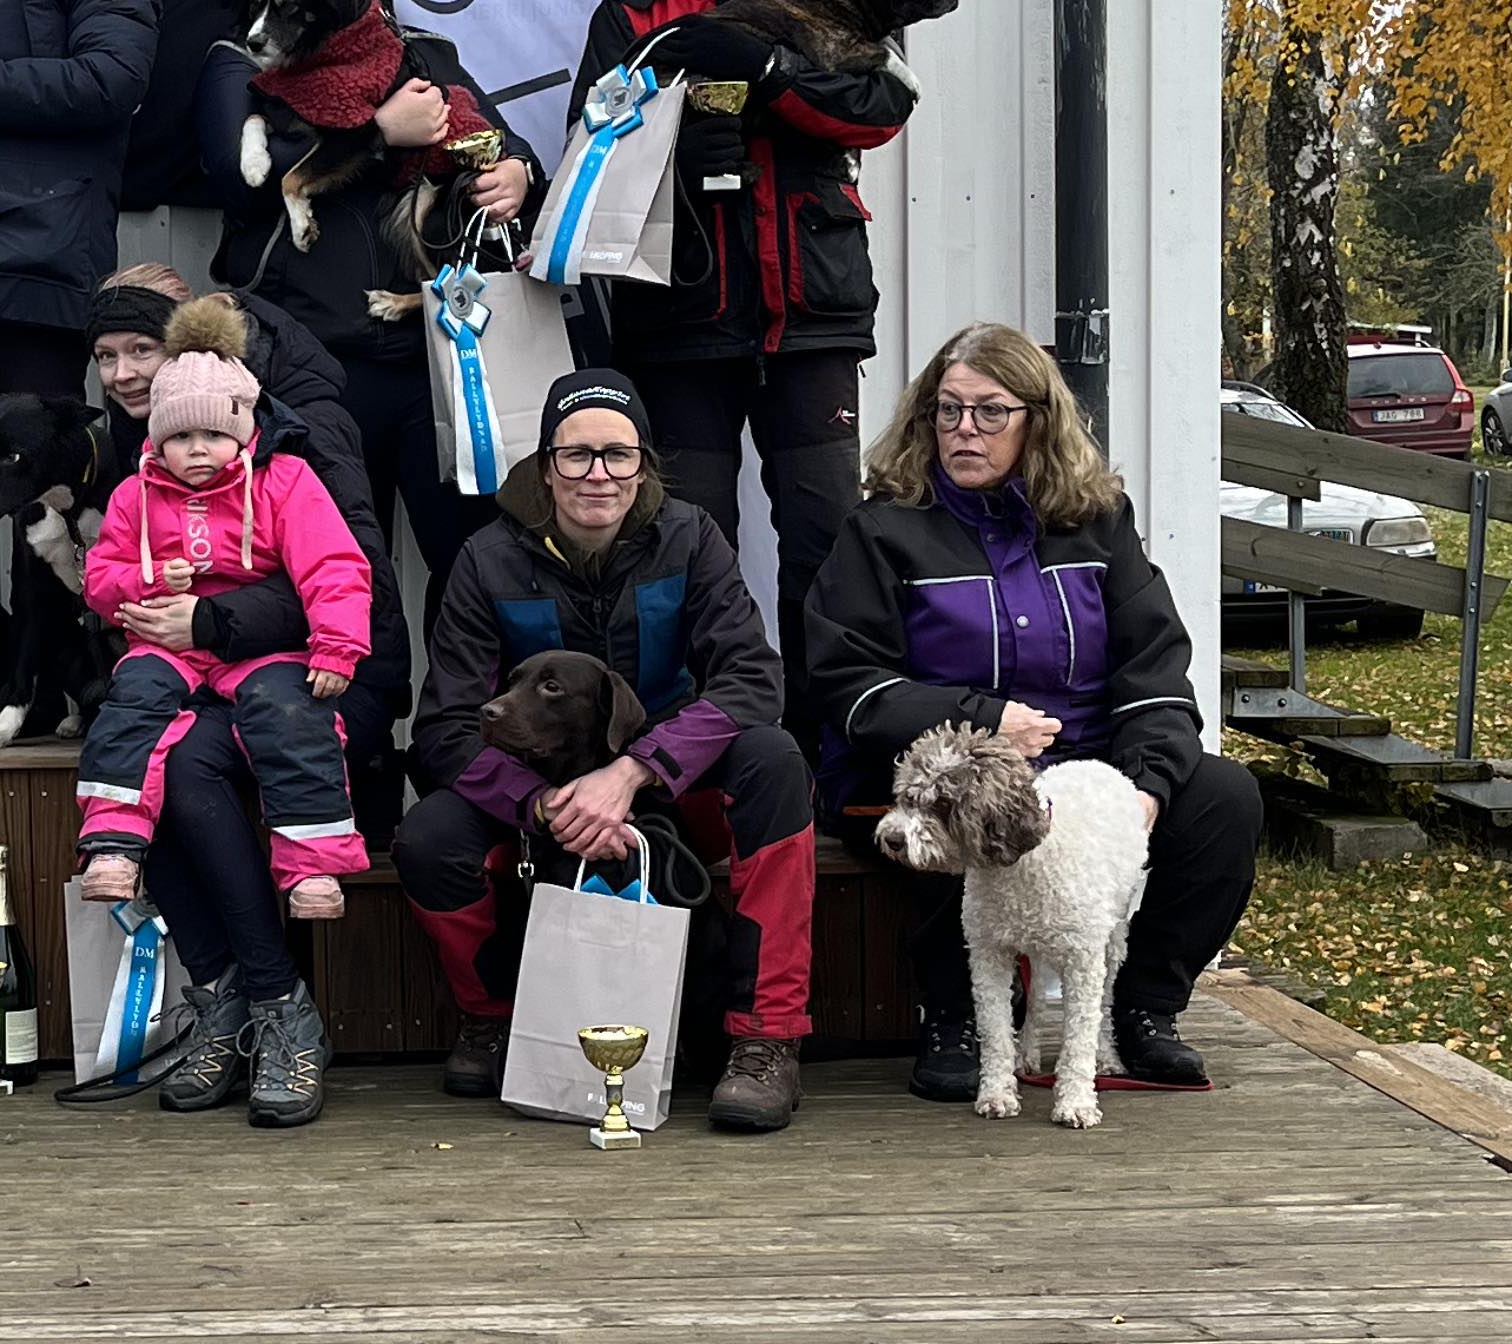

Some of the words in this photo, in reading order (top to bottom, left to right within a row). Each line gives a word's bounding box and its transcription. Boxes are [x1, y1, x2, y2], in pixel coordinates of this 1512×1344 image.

[461, 349, 477, 359] DM
[468, 366, 488, 452] RALLYLYDNAD
[135, 947, 154, 959] DM
[588, 1092, 645, 1112] FLPING
